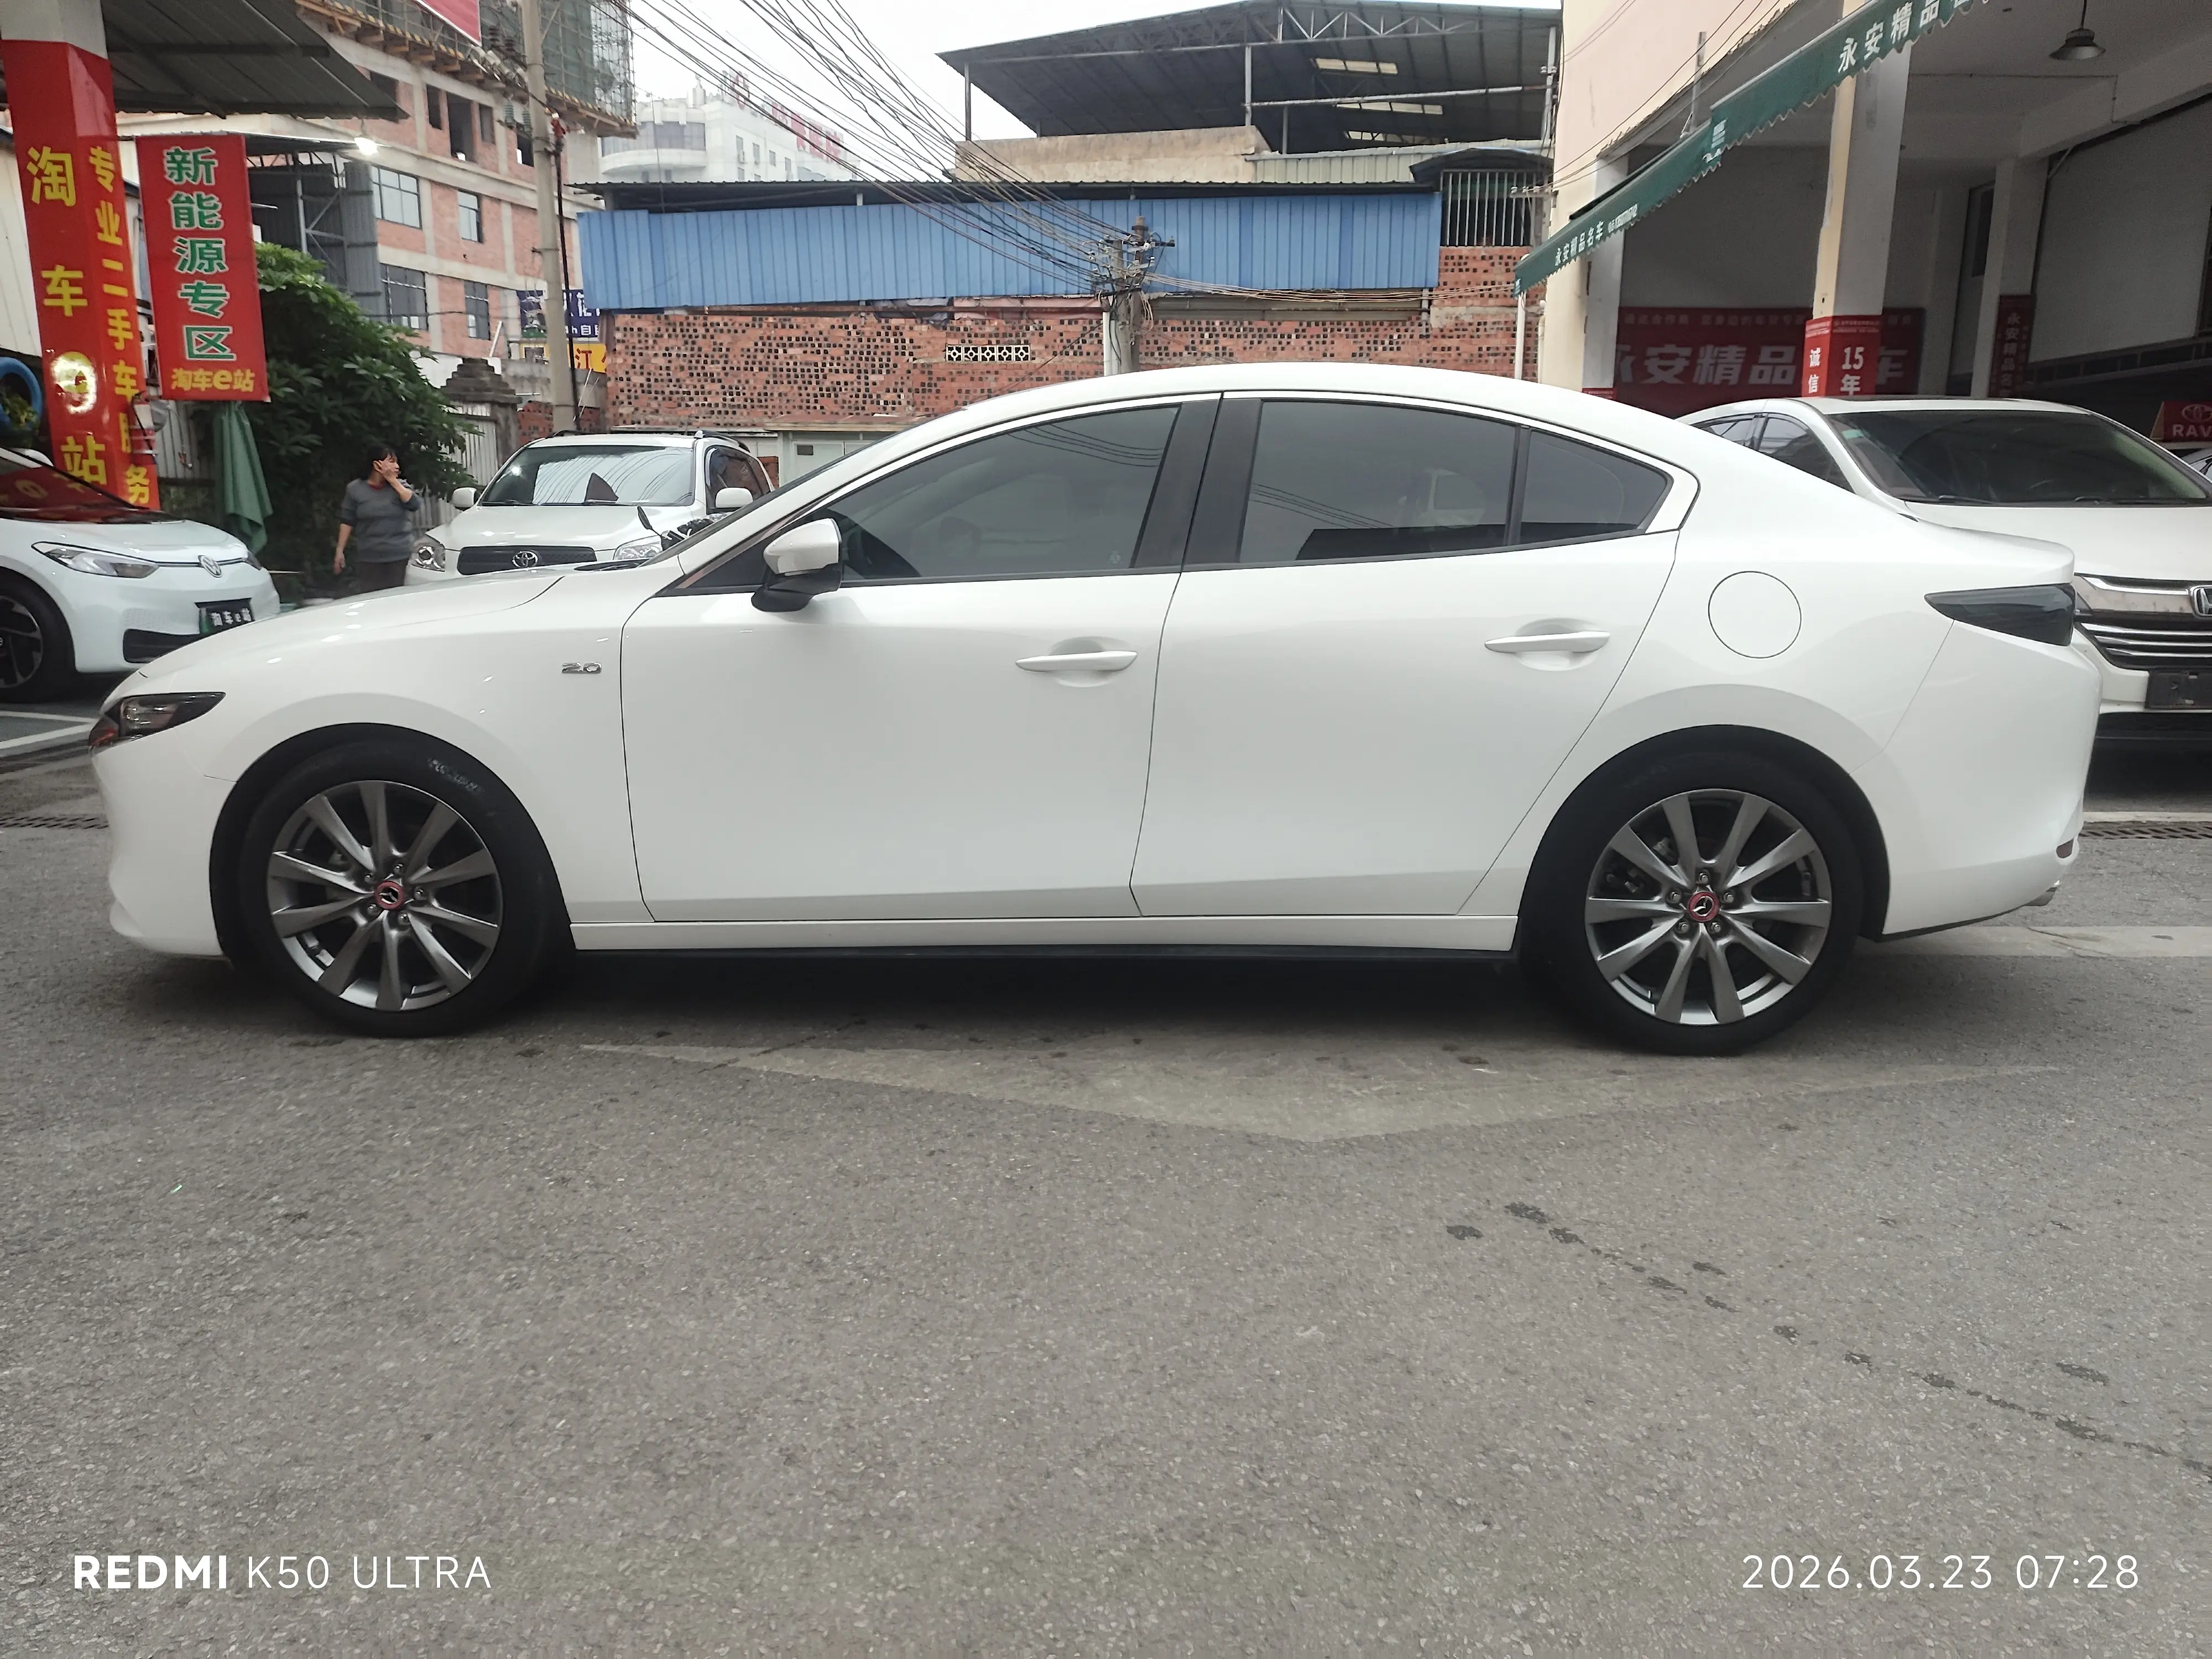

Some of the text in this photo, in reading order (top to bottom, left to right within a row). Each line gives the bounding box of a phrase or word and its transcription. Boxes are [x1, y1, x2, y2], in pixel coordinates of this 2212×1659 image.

[1838, 0, 1970, 73] 永安精品
[164, 147, 237, 361] 新能源专区
[171, 367, 255, 392] 淘车e站
[1808, 347, 1821, 394] 诚信
[562, 662, 602, 674] 2.0
